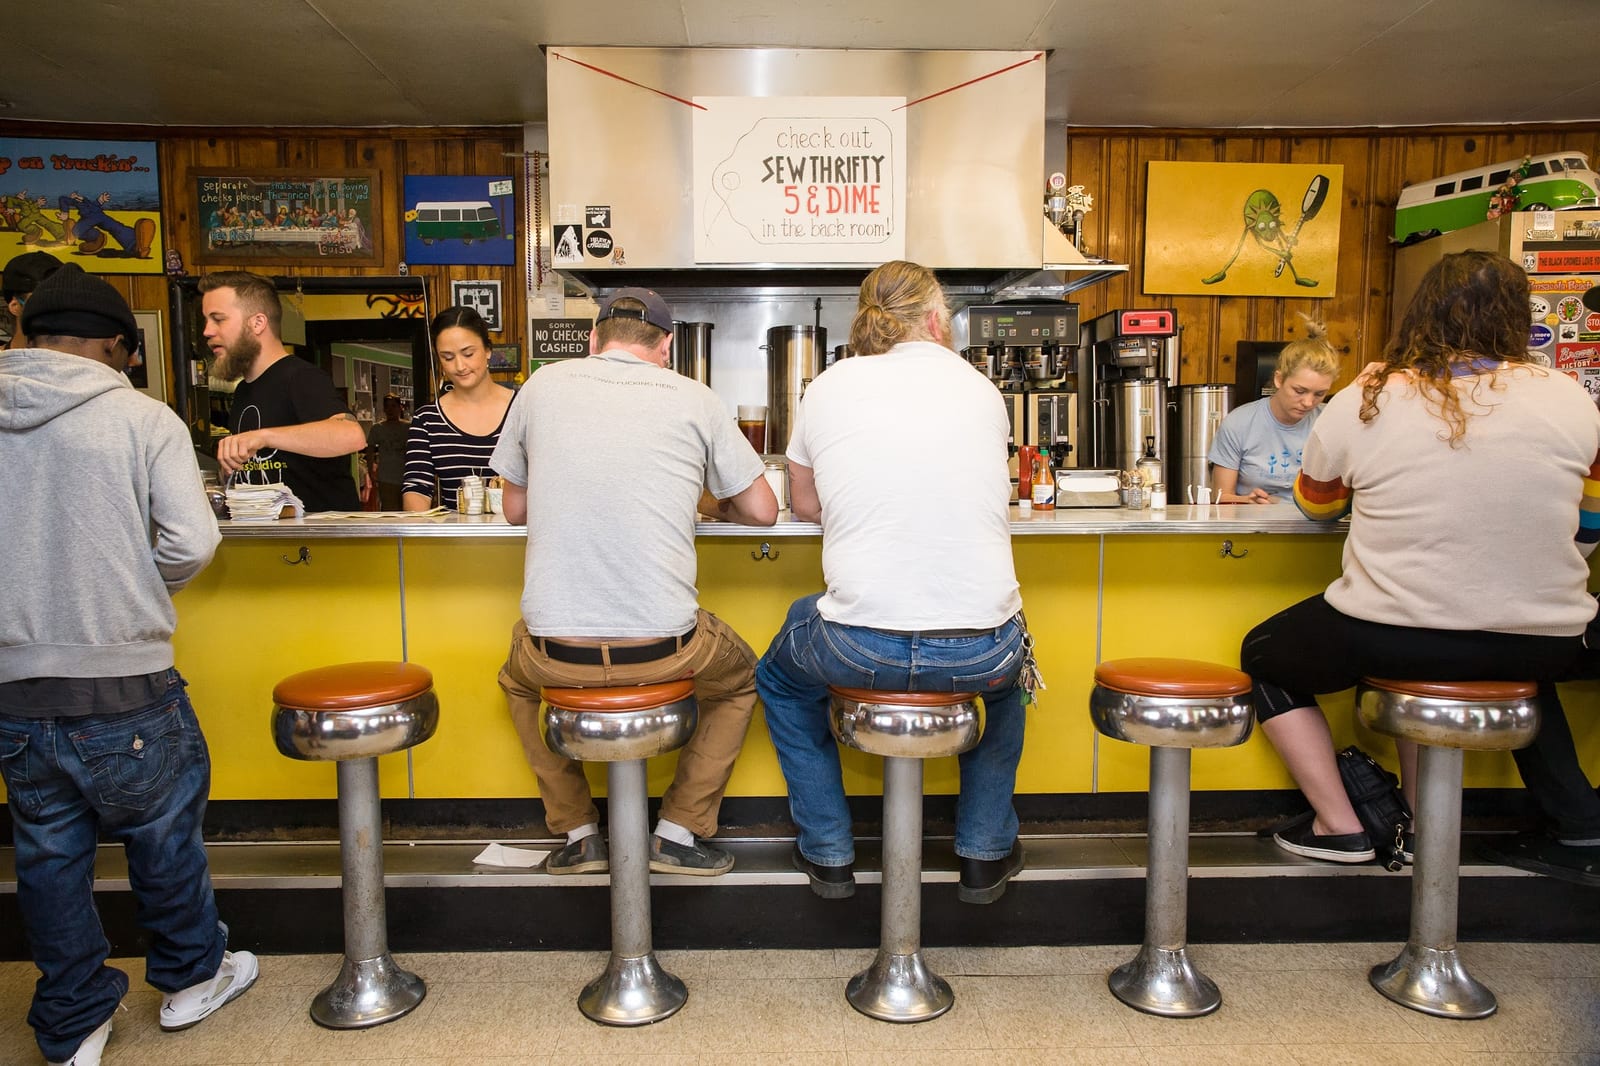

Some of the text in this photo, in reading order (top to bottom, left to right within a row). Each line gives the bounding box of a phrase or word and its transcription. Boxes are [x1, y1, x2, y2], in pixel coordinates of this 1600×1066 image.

[776, 126, 873, 149] check out
[18, 156, 45, 169] on
[784, 185, 800, 215] 5
[826, 185, 881, 214] DIME
[762, 217, 891, 238] in the back room!
[1587, 319, 1600, 327] STO
[535, 330, 590, 341] NO CHECKS
[540, 343, 584, 353] CASHED
[1562, 360, 1591, 369] VICTORY
[655, 382, 679, 391] HERO
